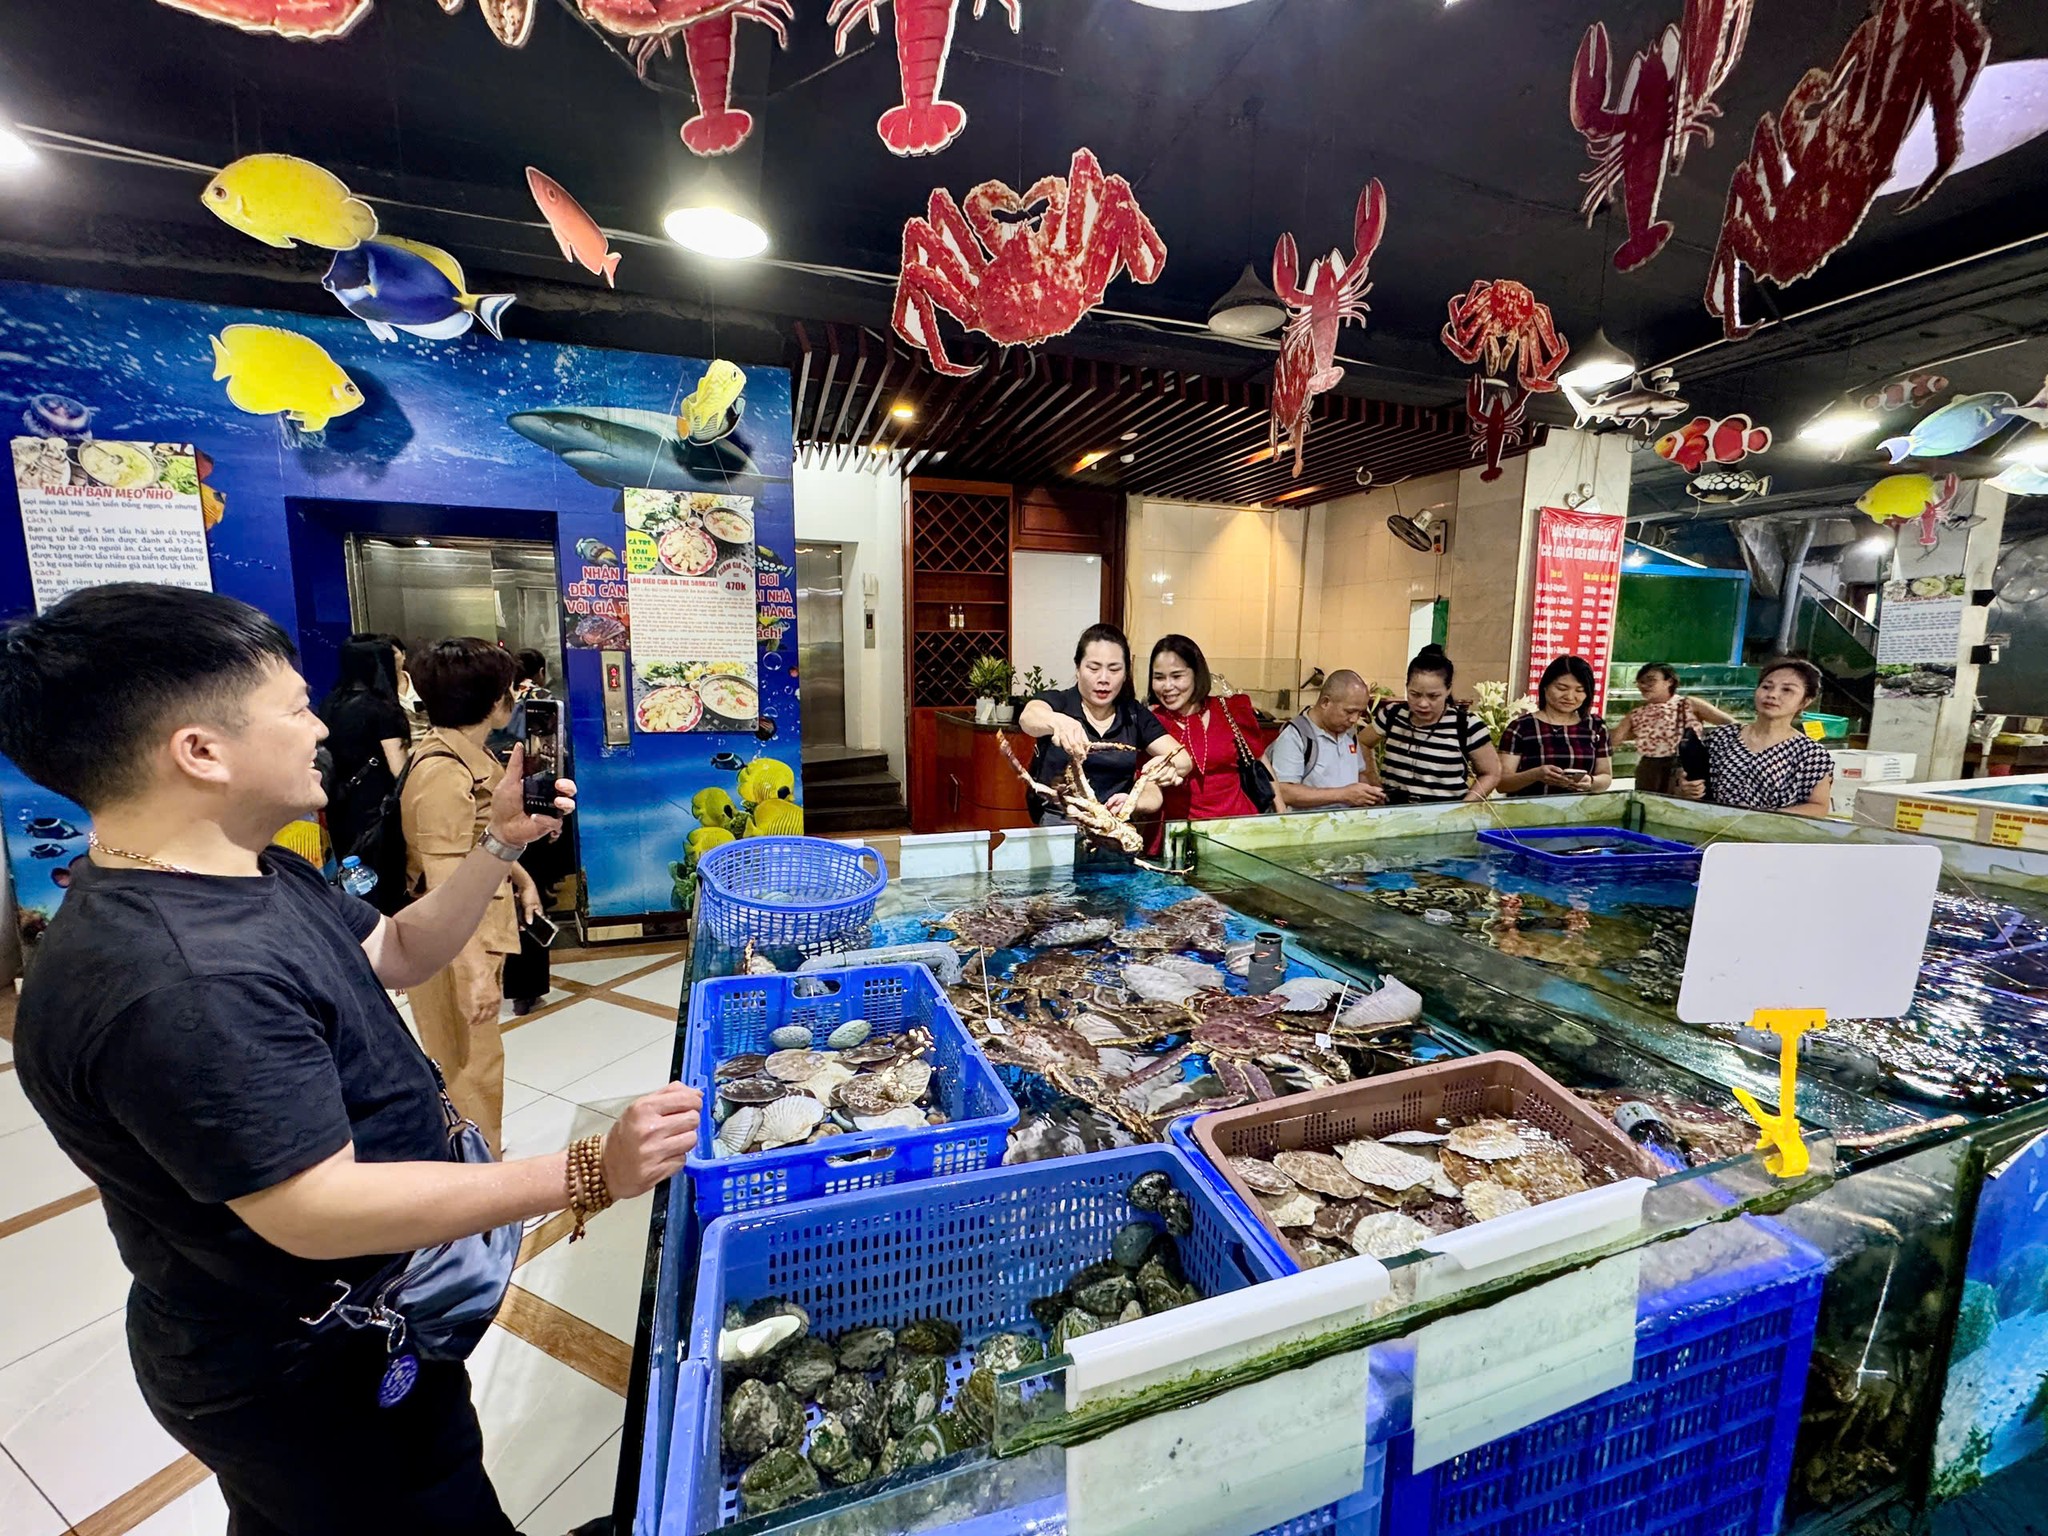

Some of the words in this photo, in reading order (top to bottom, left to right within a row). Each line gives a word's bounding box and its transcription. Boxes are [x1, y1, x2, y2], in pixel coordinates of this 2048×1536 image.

[86, 488, 112, 500] BẠN
[116, 488, 142, 501] MẸO
[74, 560, 92, 568] biển
[582, 564, 619, 582] NHẬN
[759, 573, 778, 586] BƠI
[569, 579, 595, 596] ĐẾN
[725, 581, 746, 590] 470k
[767, 588, 792, 602] NHÀ
[566, 598, 590, 614] VỚI
[593, 599, 615, 614] GIÁ
[761, 604, 796, 619] HÀNG.
[757, 626, 782, 639] ách!
